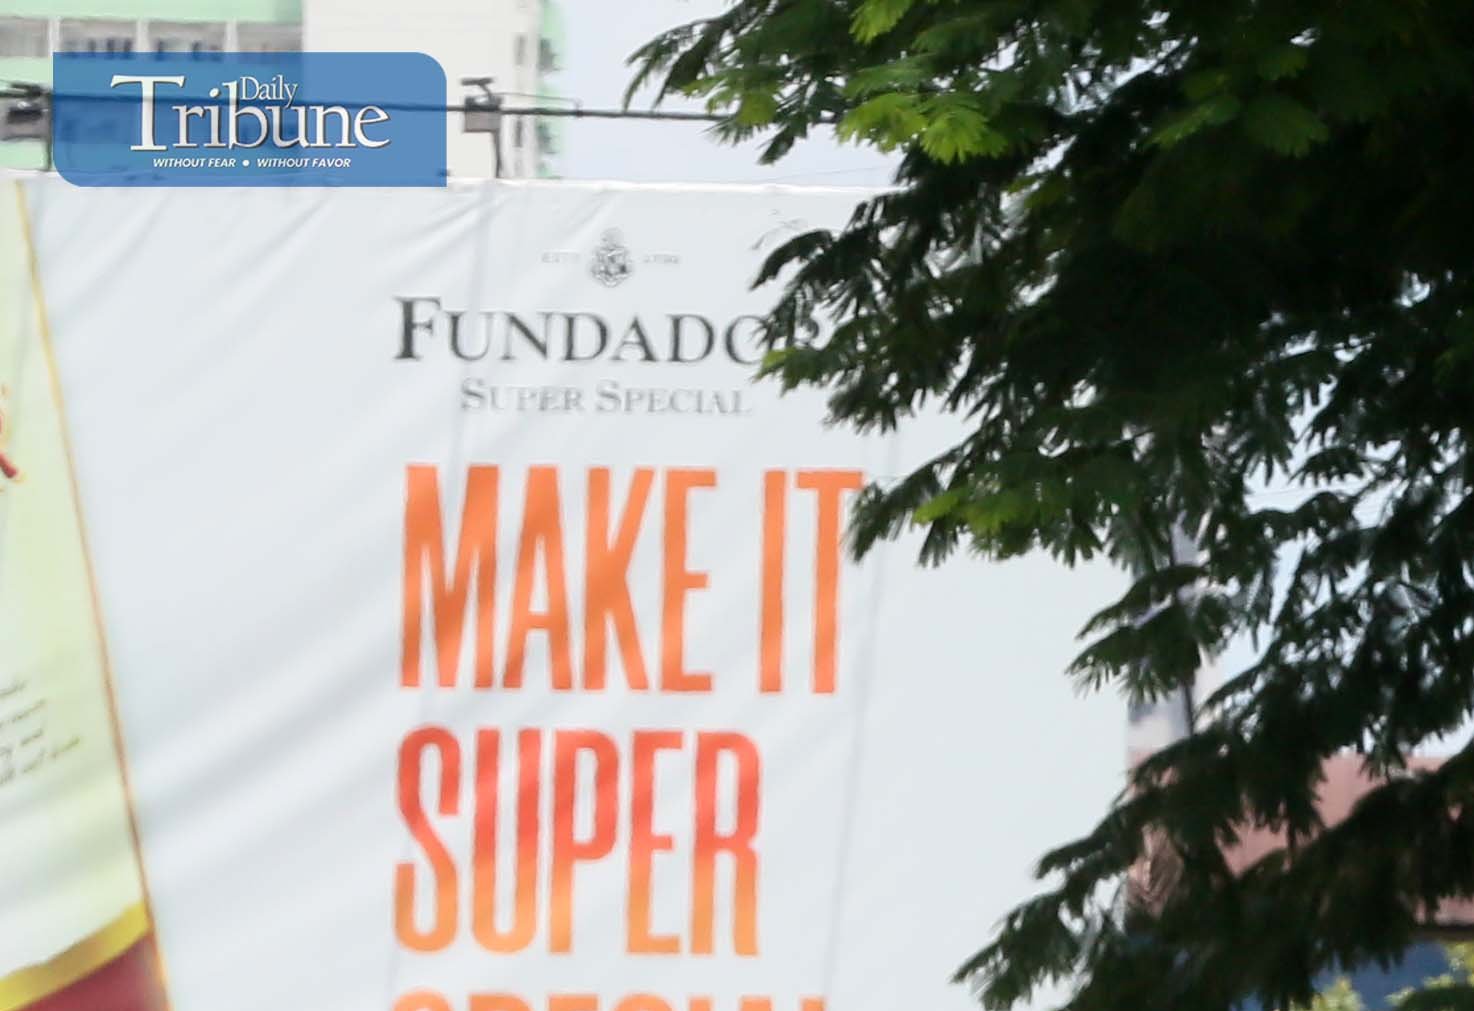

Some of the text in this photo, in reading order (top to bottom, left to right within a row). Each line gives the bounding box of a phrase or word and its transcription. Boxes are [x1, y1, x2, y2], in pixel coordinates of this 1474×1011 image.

[460, 377, 753, 416] SUPER SPECIAL
[400, 463, 865, 694] MAKE IT
[393, 725, 763, 957] SUPER
